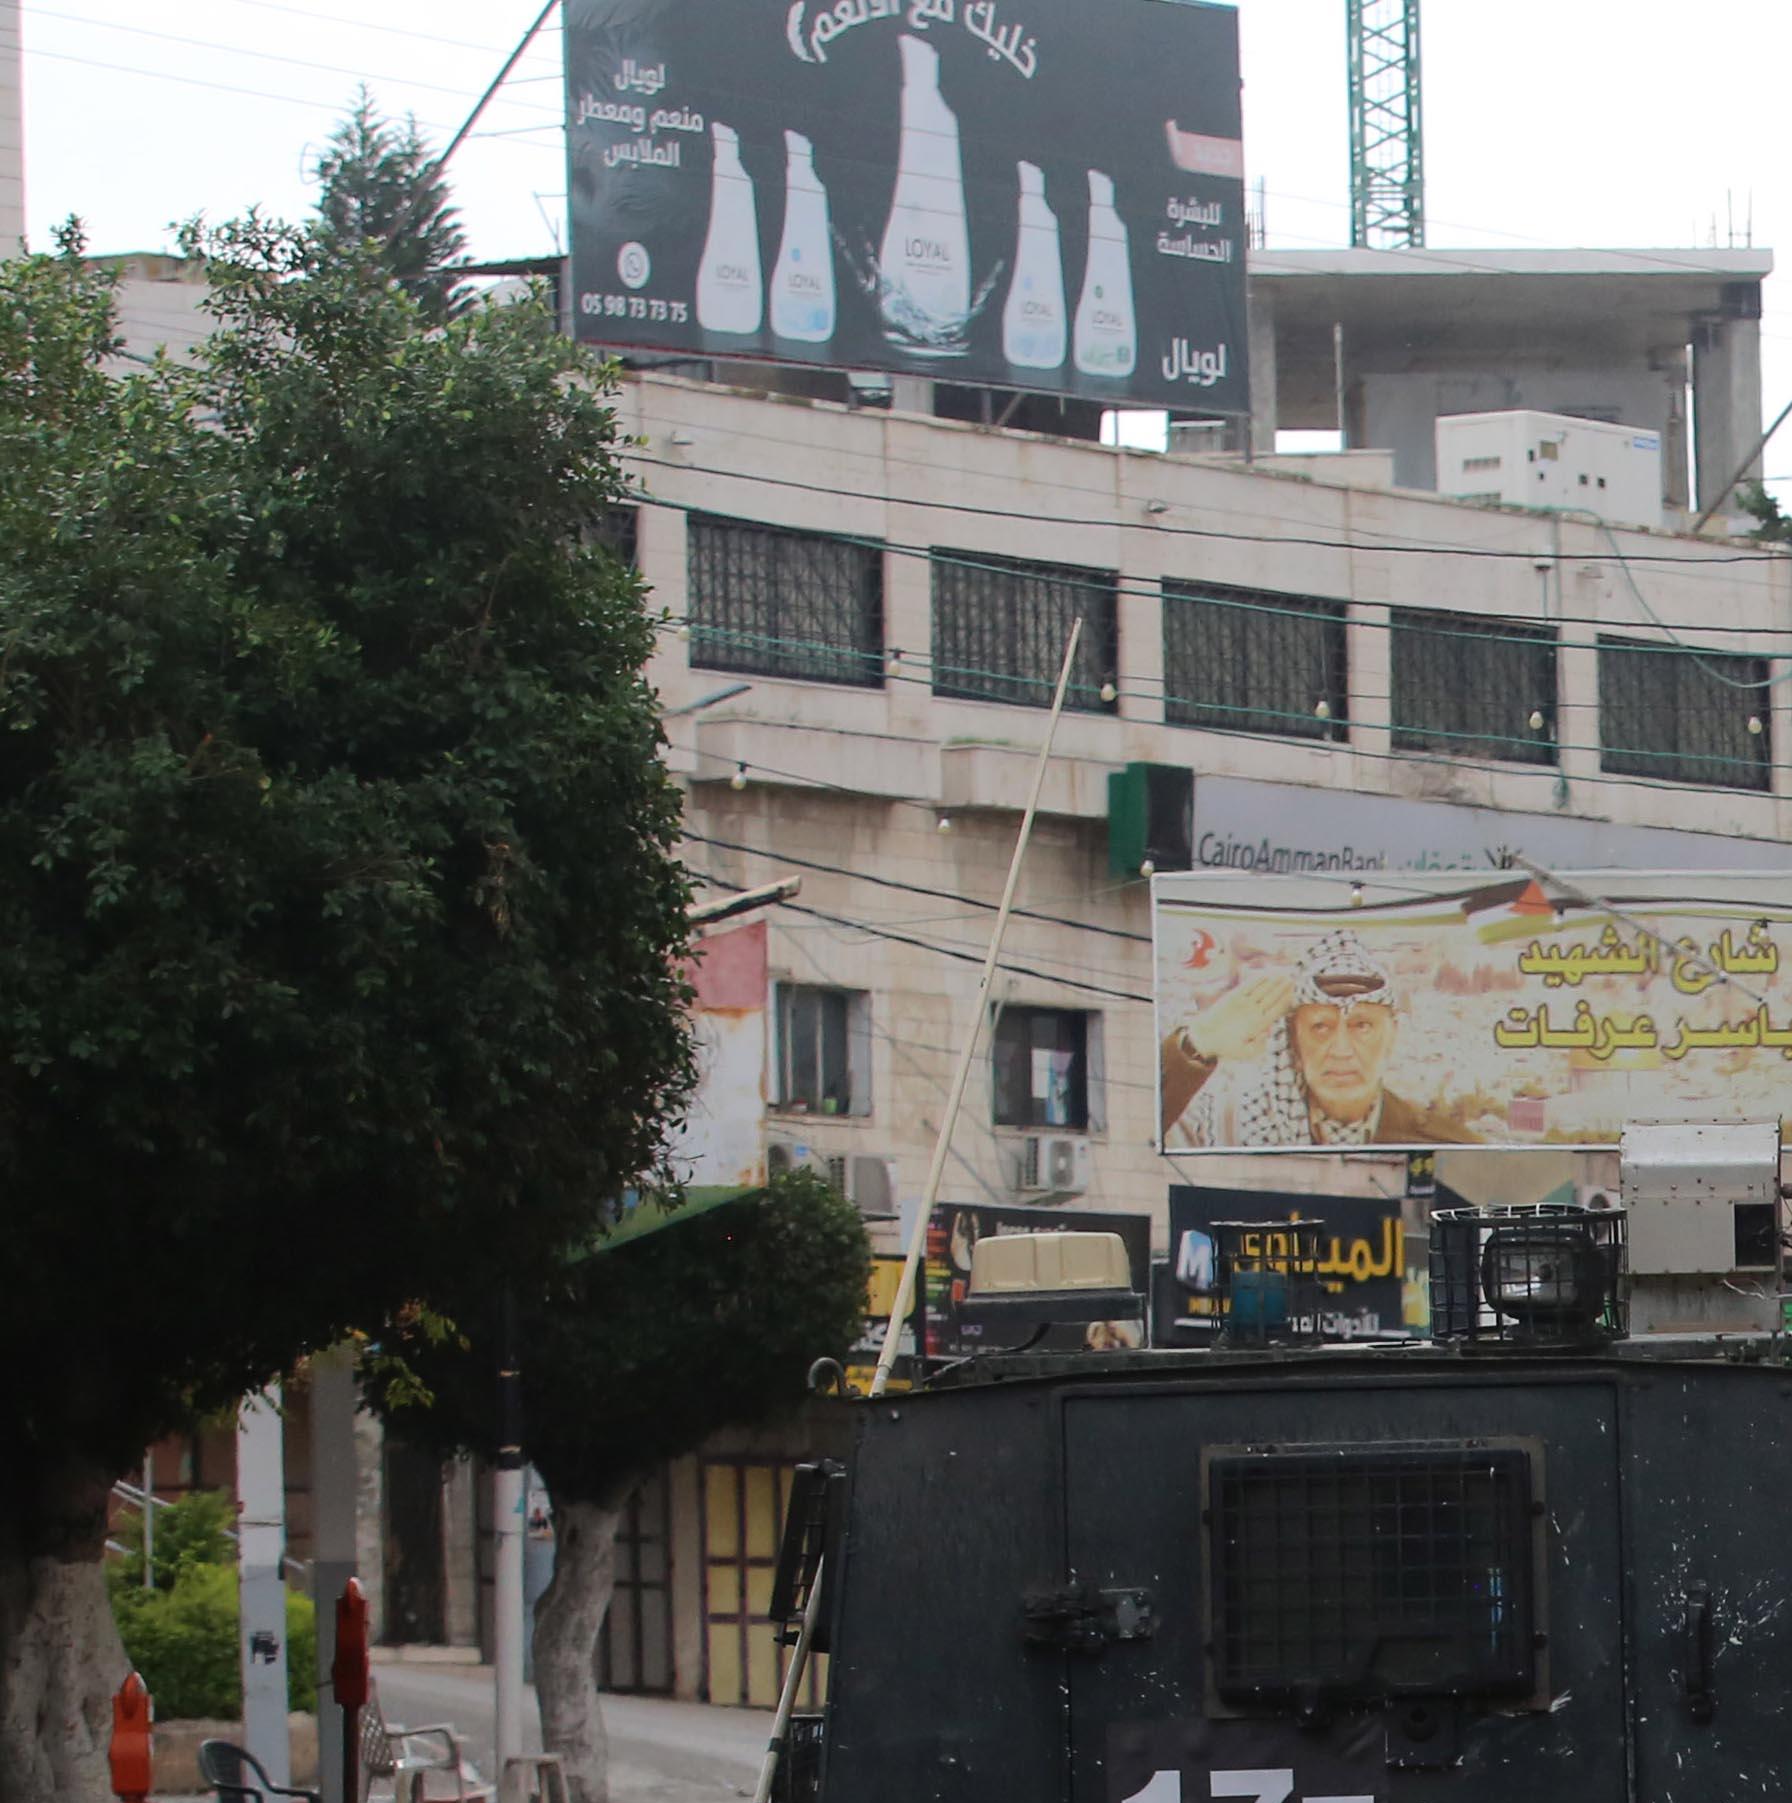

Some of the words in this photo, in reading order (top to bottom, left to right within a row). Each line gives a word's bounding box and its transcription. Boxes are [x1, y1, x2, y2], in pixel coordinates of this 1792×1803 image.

[614, 62, 665, 92] لويال
[649, 107, 704, 134] منعم
[602, 139, 680, 170] الملابس
[904, 236, 952, 263] LOYAL
[1161, 336, 1227, 387] لويال
[1200, 830, 1386, 873] CairoAmmanBan
[1517, 922, 1660, 977] الشهيد
[1670, 927, 1779, 995] شارع
[1492, 1005, 1660, 1062] عرفات
